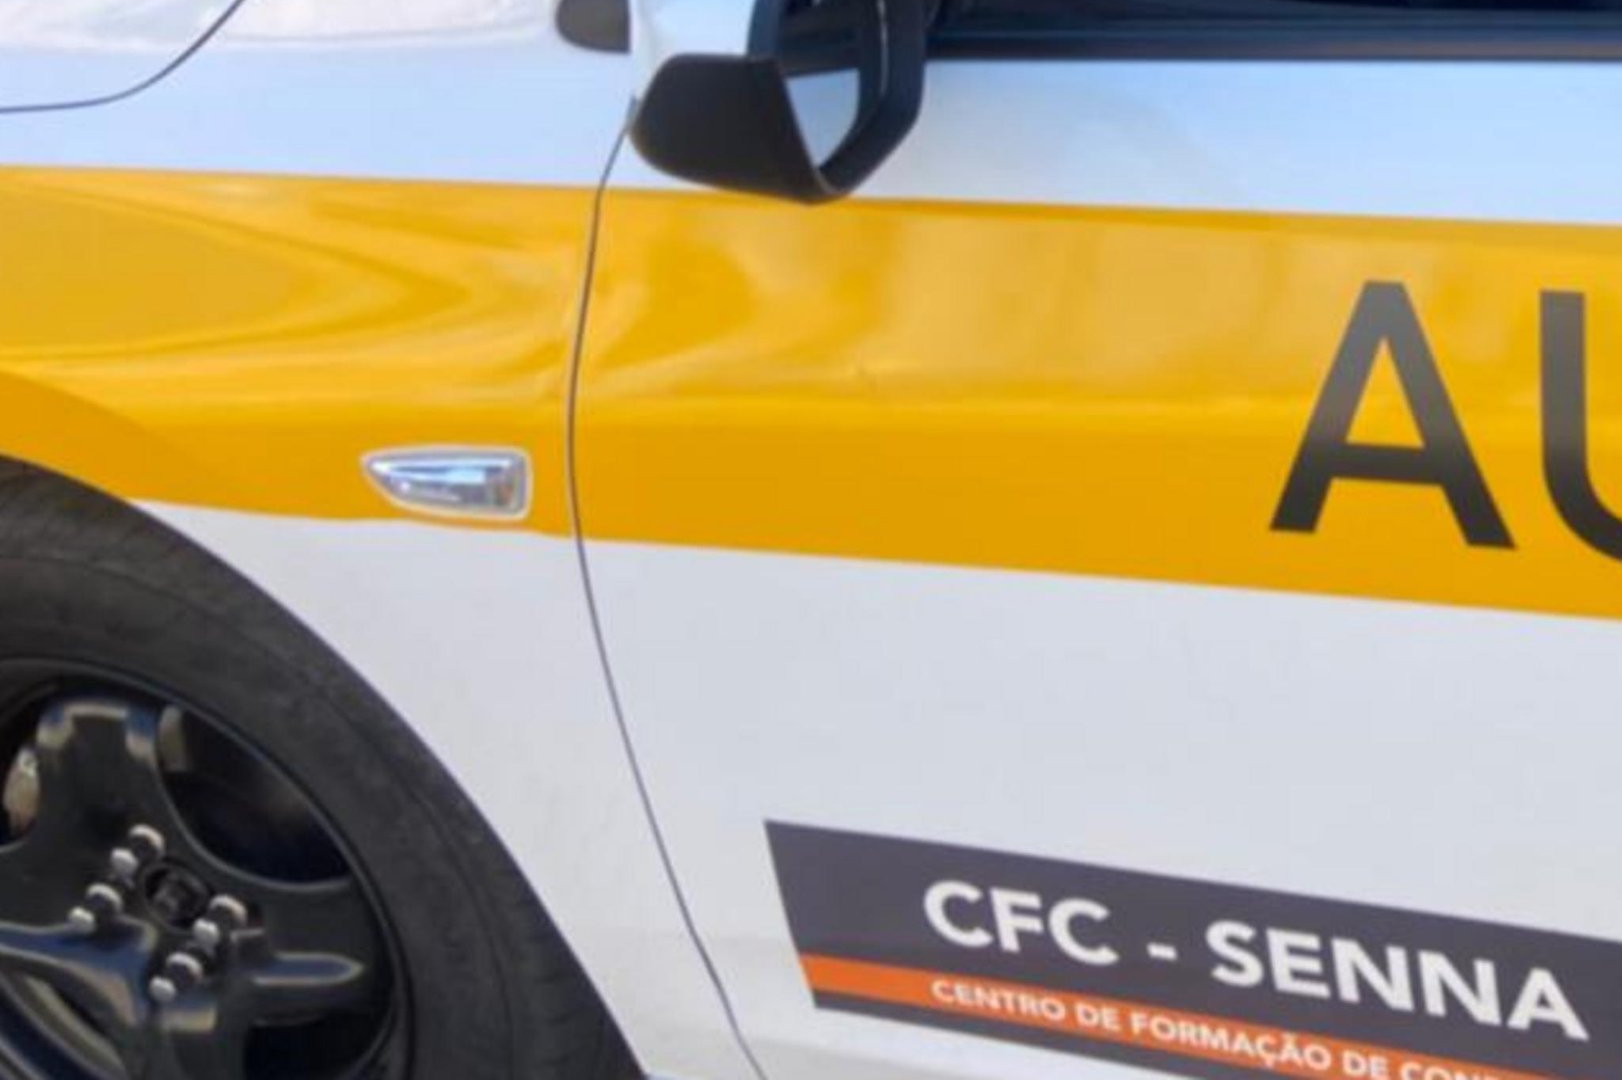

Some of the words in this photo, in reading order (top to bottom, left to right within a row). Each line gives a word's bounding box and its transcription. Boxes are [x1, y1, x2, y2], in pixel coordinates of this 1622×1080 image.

[923, 880, 1120, 966] CFC
[1147, 942, 1178, 961] -
[1205, 919, 1590, 1042] SENNA
[930, 979, 1067, 1021] CENTRO
[1074, 1001, 1122, 1032] DE
[1129, 1011, 1332, 1071] FORMAÇÃO
[1341, 1049, 1389, 1080] DE
